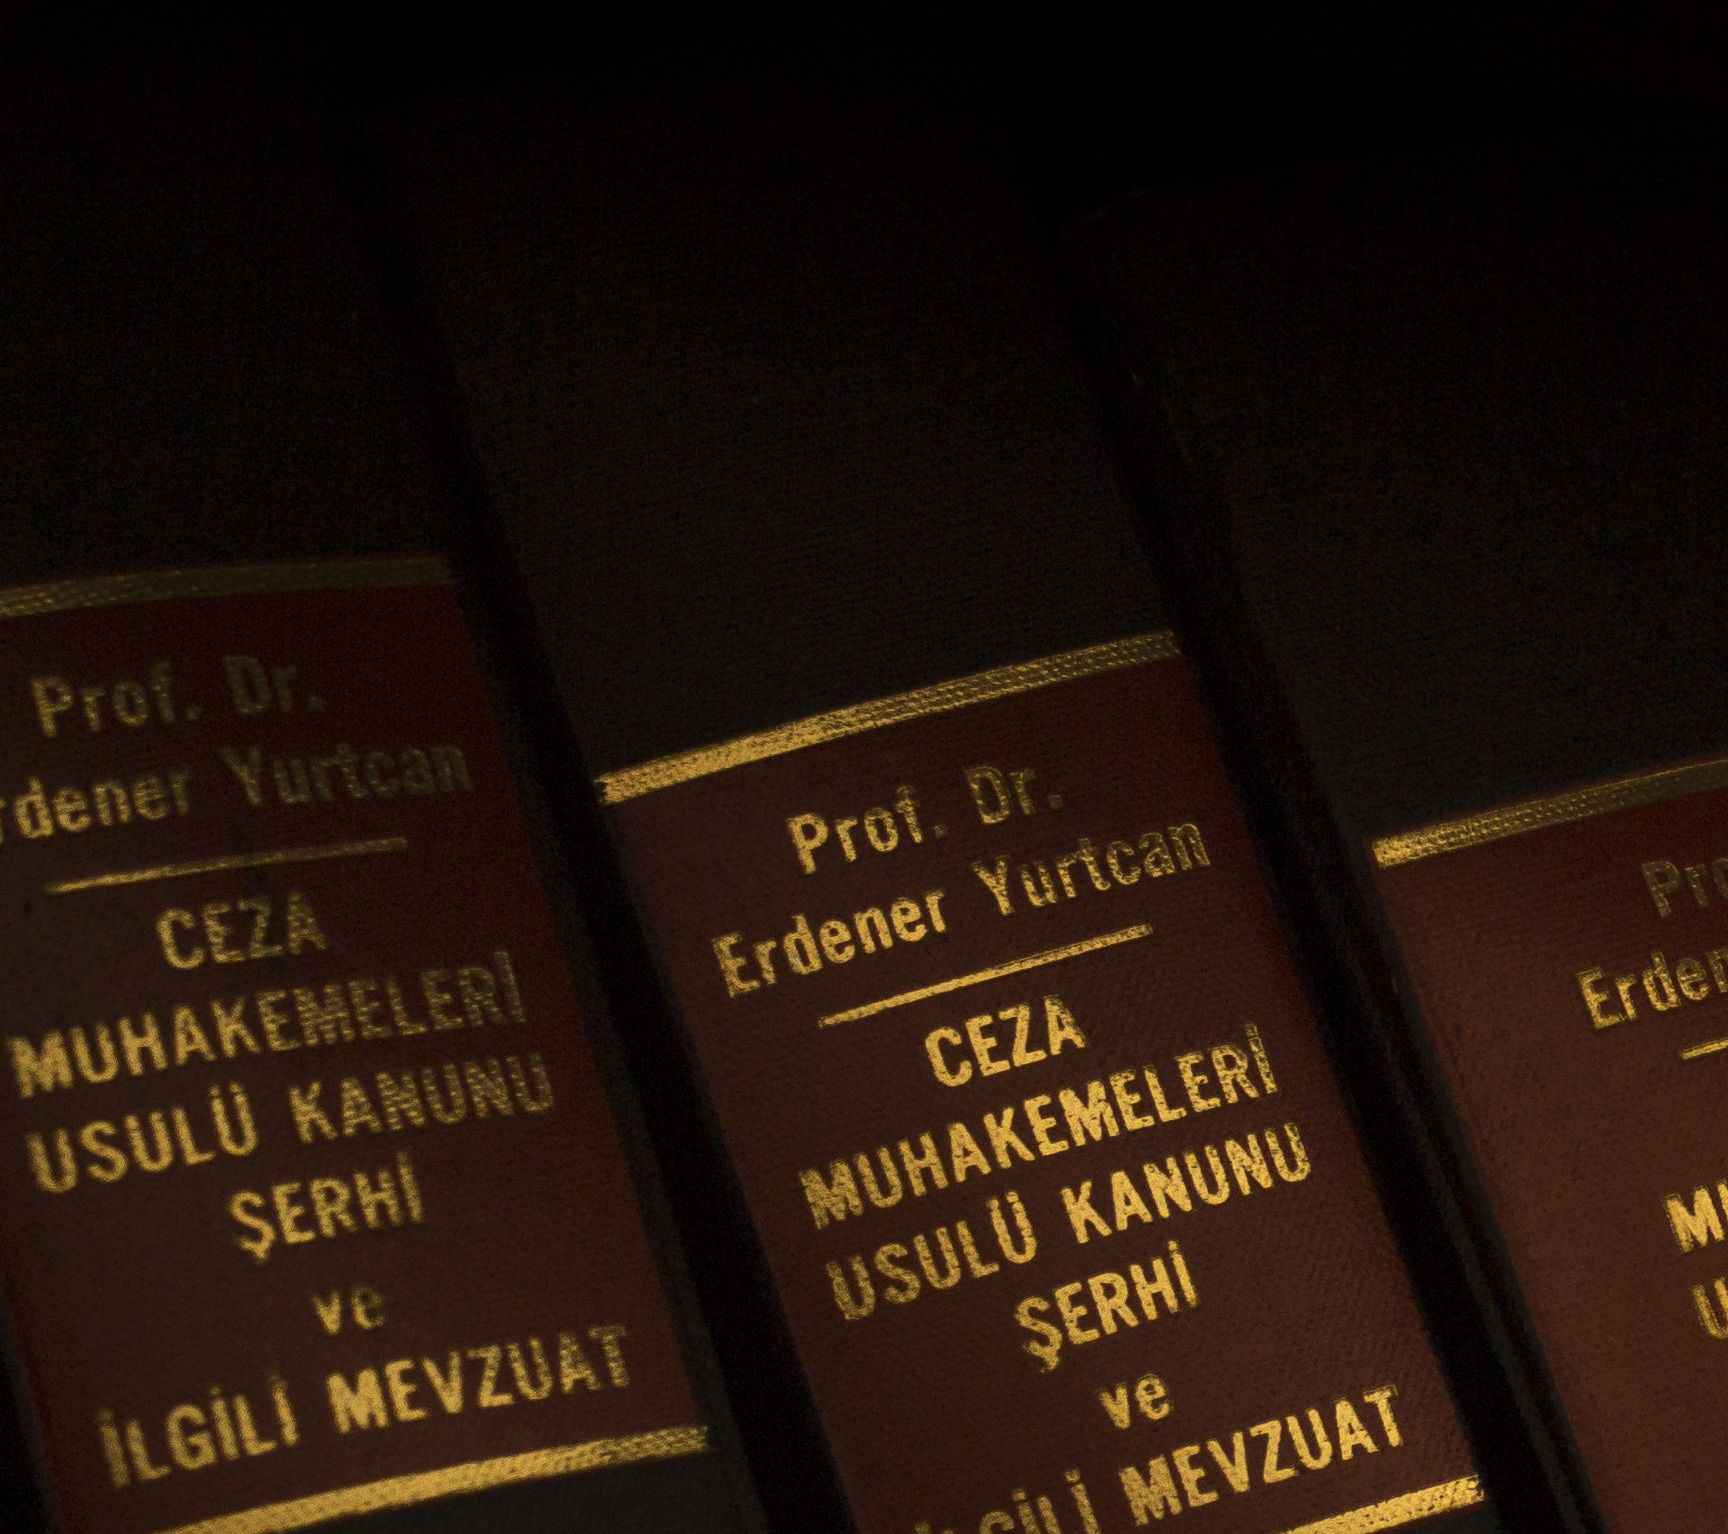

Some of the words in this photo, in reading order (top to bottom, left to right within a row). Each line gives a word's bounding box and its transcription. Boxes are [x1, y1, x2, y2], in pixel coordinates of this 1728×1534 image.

[30, 660, 201, 738] Prof.
[223, 655, 324, 716] Dr.
[219, 740, 473, 806] Yurtcan
[786, 785, 945, 875] Prof.
[965, 765, 1064, 828] Dr.
[157, 891, 328, 971] CEZA
[712, 883, 948, 998] Erdener
[974, 822, 1212, 920] Yurtcan
[7, 951, 527, 1097] MUHAKEMELERİ
[924, 993, 1087, 1088] CEZA
[27, 1084, 258, 1194] USULÜ
[290, 1052, 554, 1143] KANUNU
[799, 1021, 1279, 1229] MUHAKEMELERİ
[228, 1153, 424, 1263] ŞERHİ
[825, 1188, 1040, 1322] USULÜ
[1061, 1120, 1313, 1243] KANUNU
[311, 1286, 384, 1335] ve
[1012, 1238, 1199, 1373] ŞERHİ
[99, 1372, 299, 1490] İLGİLİ
[325, 1325, 631, 1436] MEVZUAT
[1098, 1371, 1171, 1431] ve
[1118, 1383, 1405, 1528] MEVZUAT
